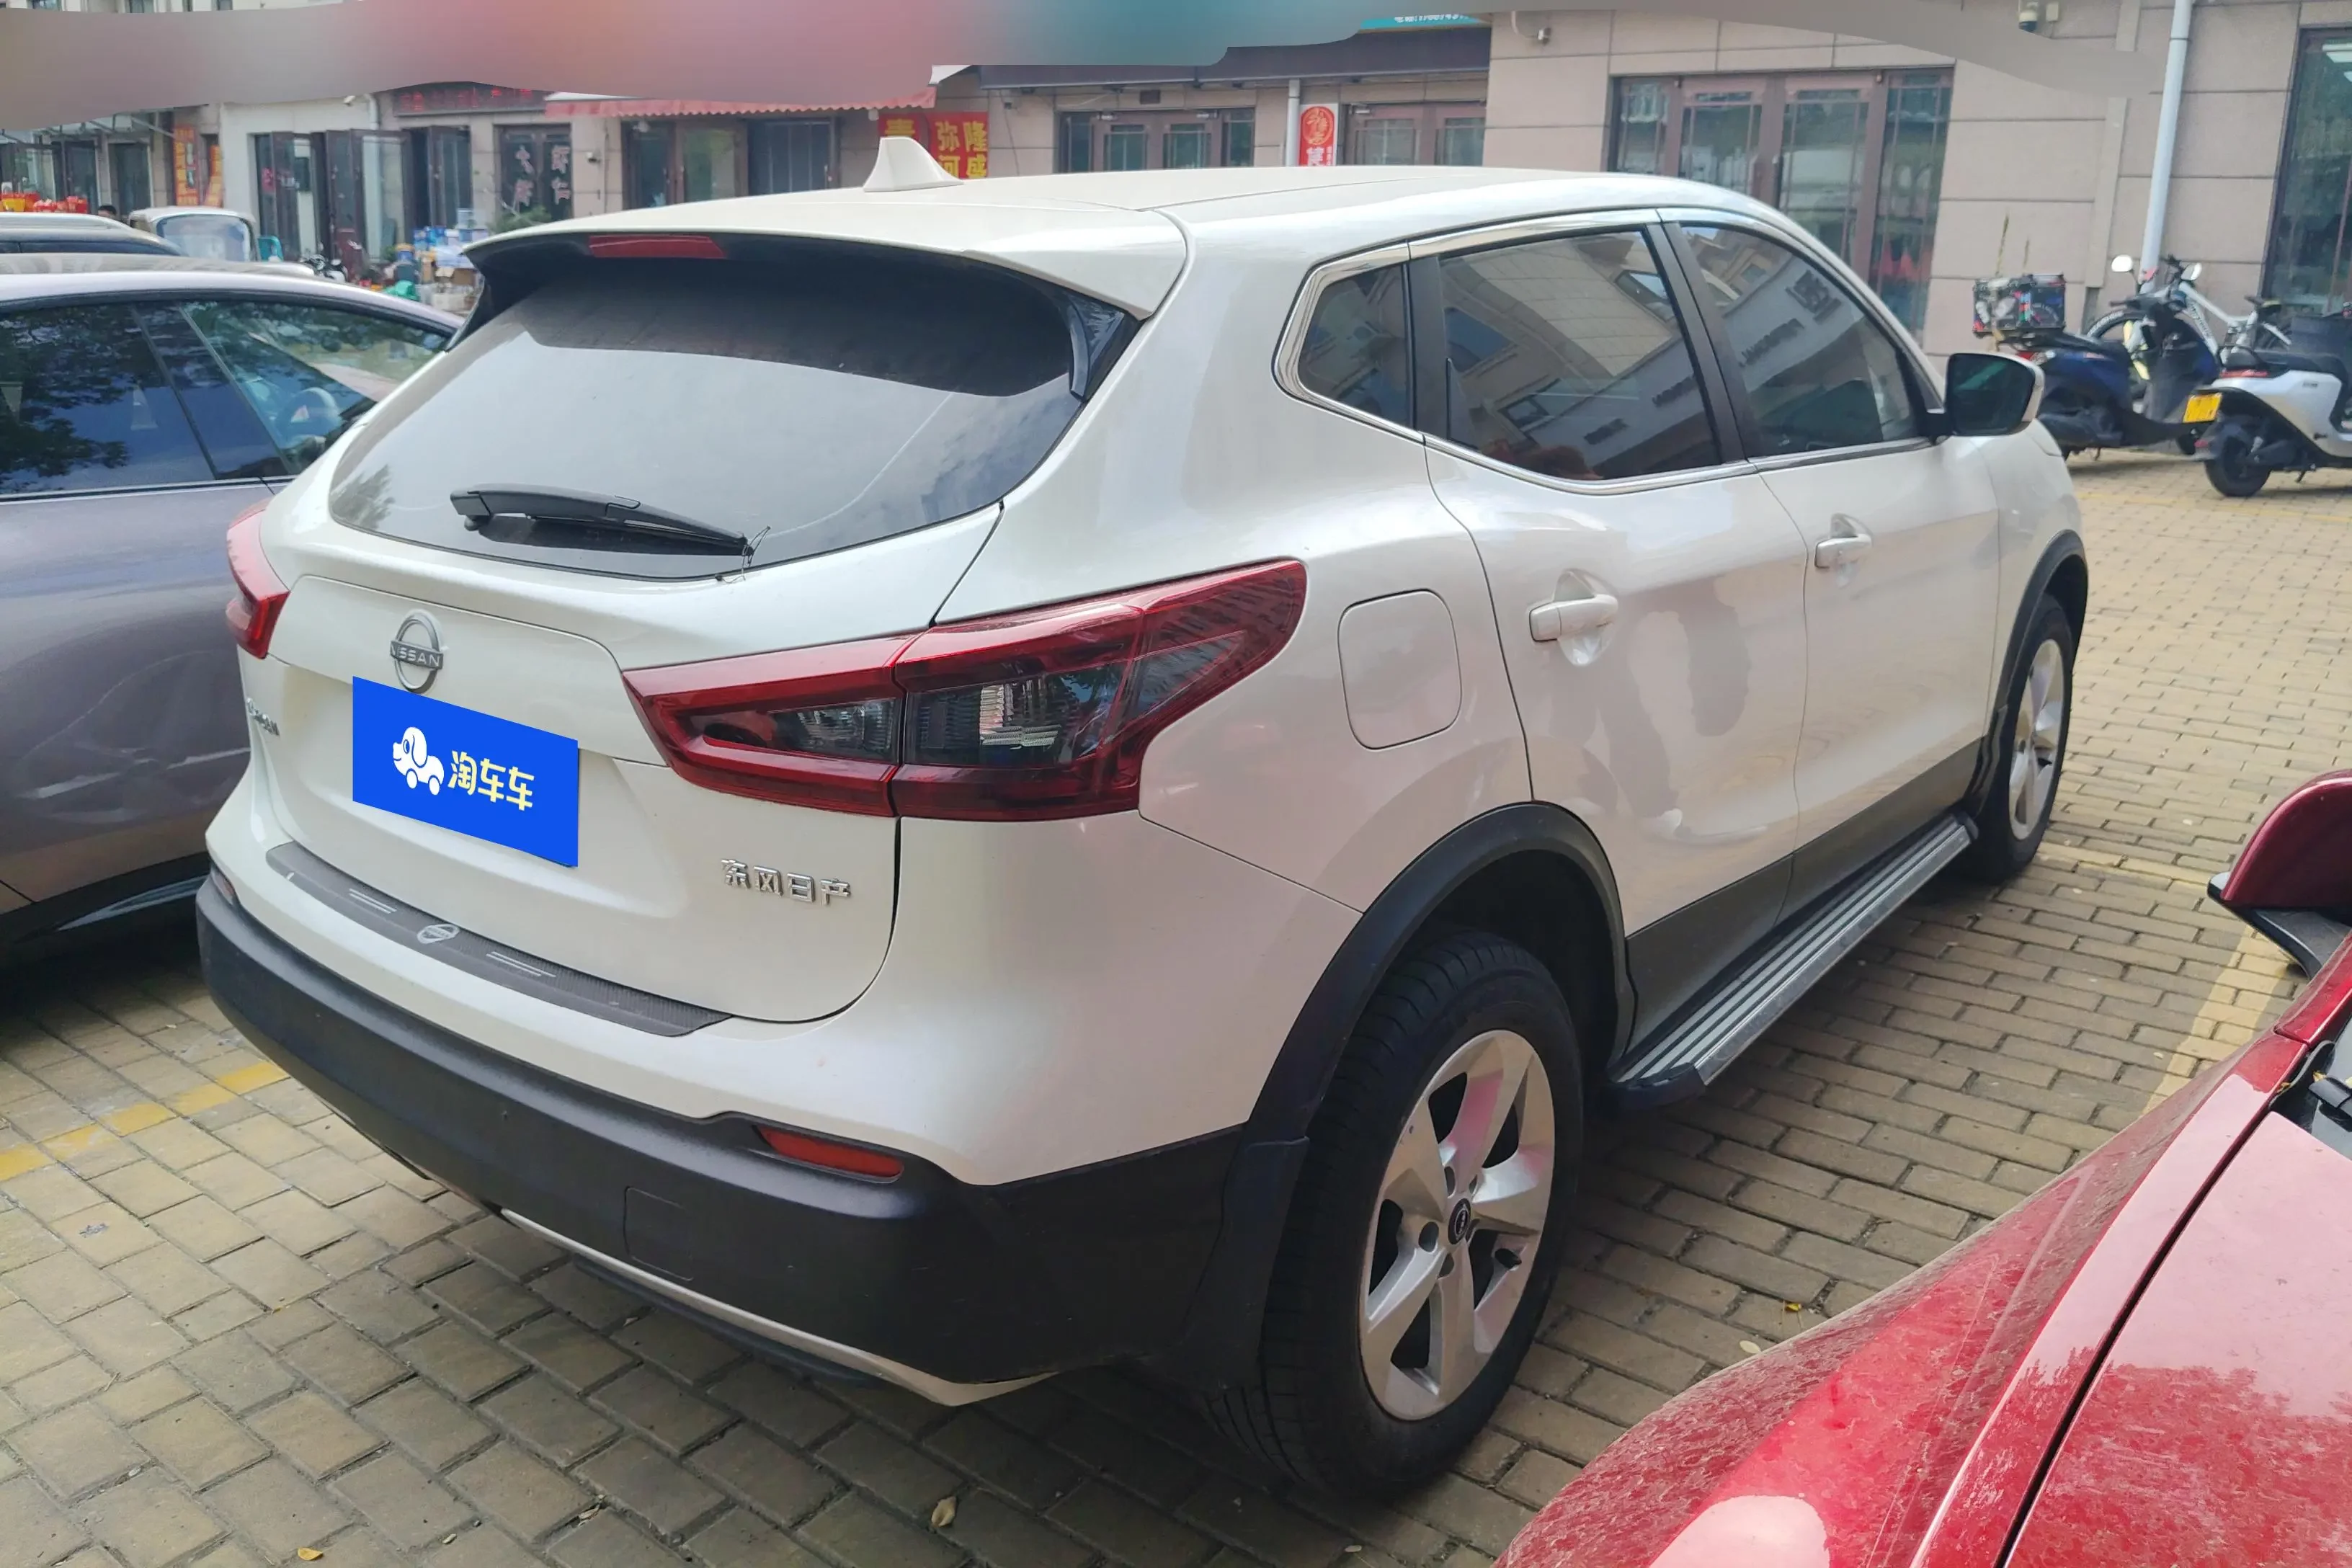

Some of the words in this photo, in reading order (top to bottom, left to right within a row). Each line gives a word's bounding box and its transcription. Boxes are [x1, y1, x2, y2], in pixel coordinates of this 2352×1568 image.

[390, 644, 441, 667] NISSAN
[721, 858, 851, 906] 东风日产
